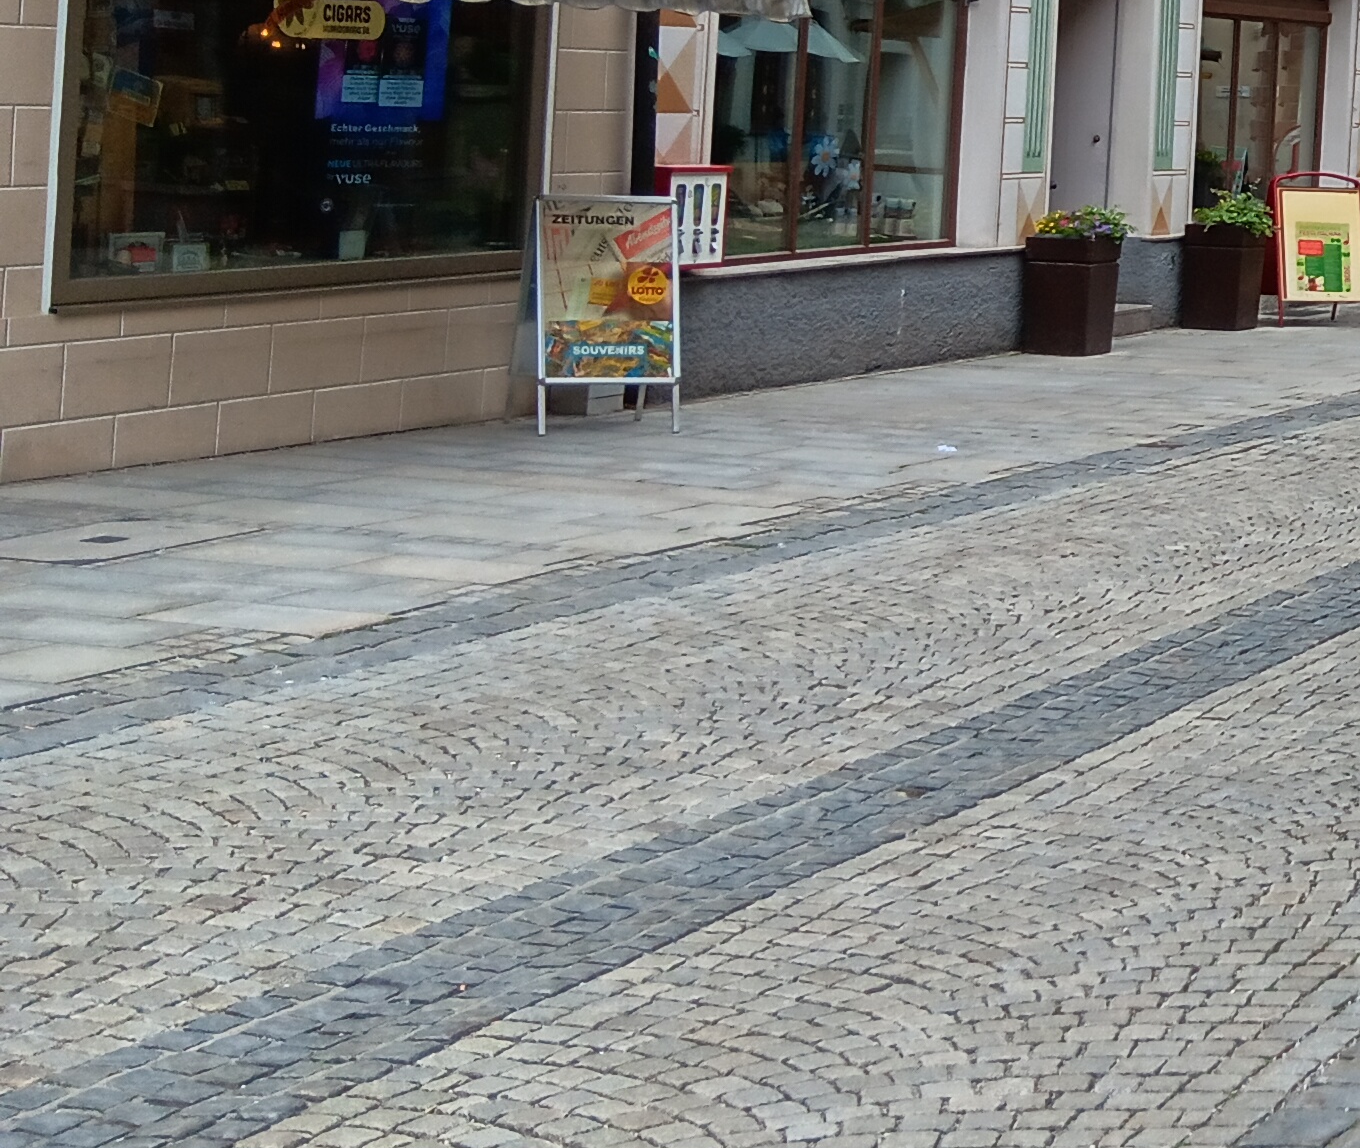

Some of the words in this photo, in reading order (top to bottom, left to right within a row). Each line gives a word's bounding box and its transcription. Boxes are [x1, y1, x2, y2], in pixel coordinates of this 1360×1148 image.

[323, 3, 372, 24] CIGARS
[330, 123, 362, 133] Echter
[552, 214, 634, 226] ZEITUNGEN
[631, 286, 664, 296] LOTTO
[573, 345, 645, 355] SOUVENIRS
